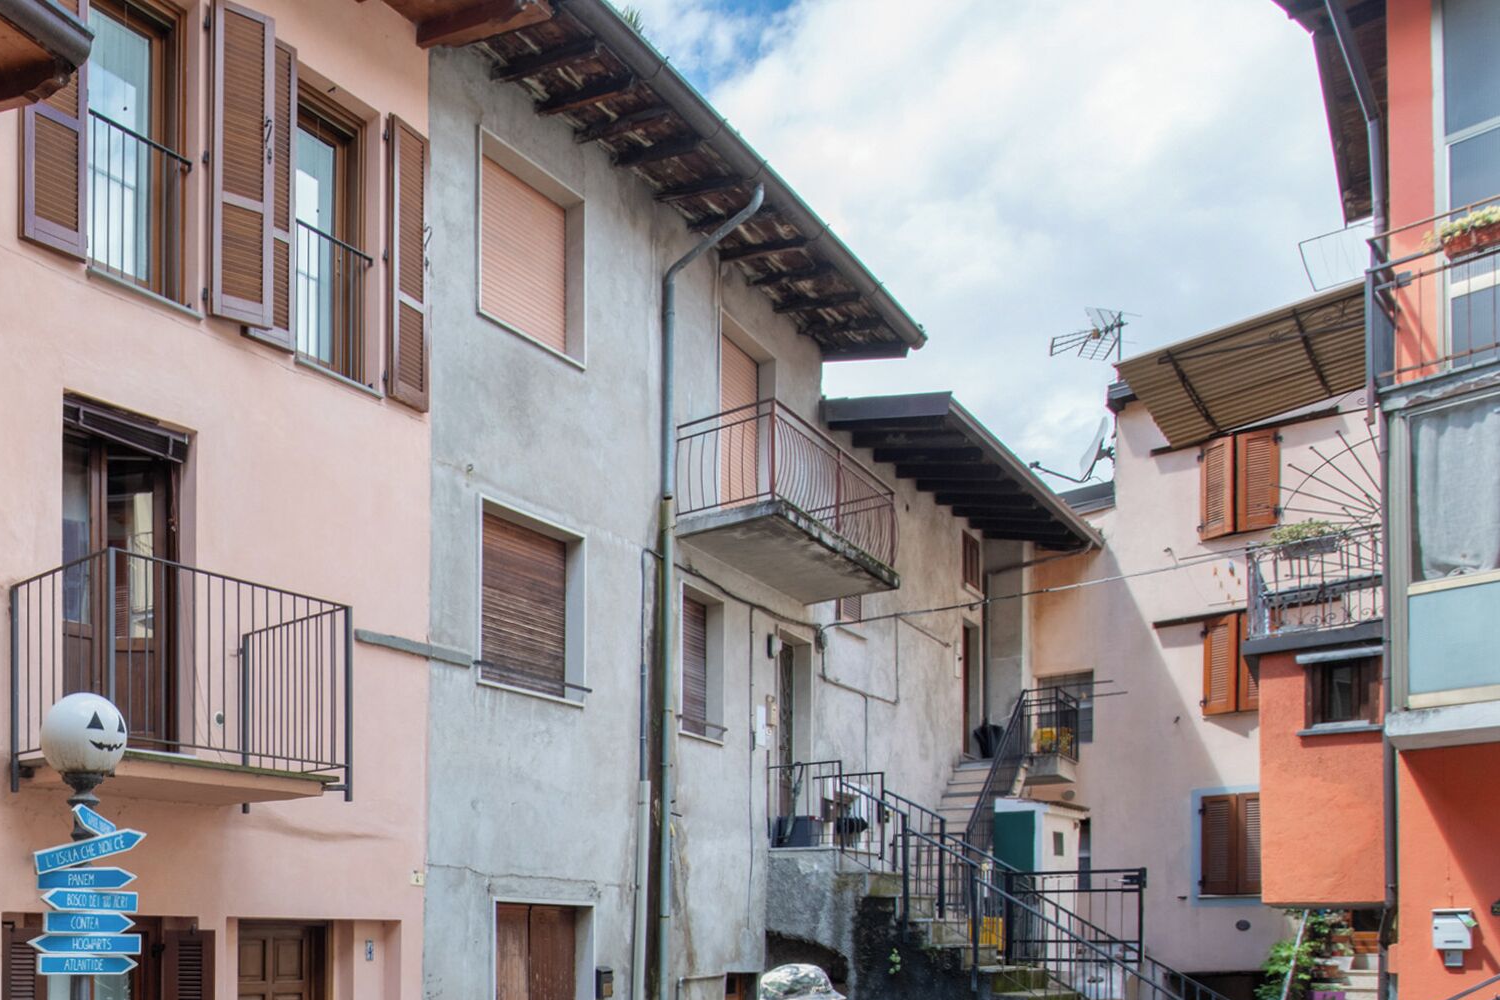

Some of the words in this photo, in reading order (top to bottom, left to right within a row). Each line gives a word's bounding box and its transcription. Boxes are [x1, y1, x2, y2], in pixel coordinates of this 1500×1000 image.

[81, 843, 96, 859] CHE
[98, 839, 113, 854] NON
[67, 873, 95, 886] PANEM
[66, 893, 87, 907] BOSCO
[89, 895, 100, 907] DEI
[70, 916, 99, 930] CONTEA
[72, 938, 112, 950] HOGWARTS
[64, 959, 104, 970] ATLANTIDE
